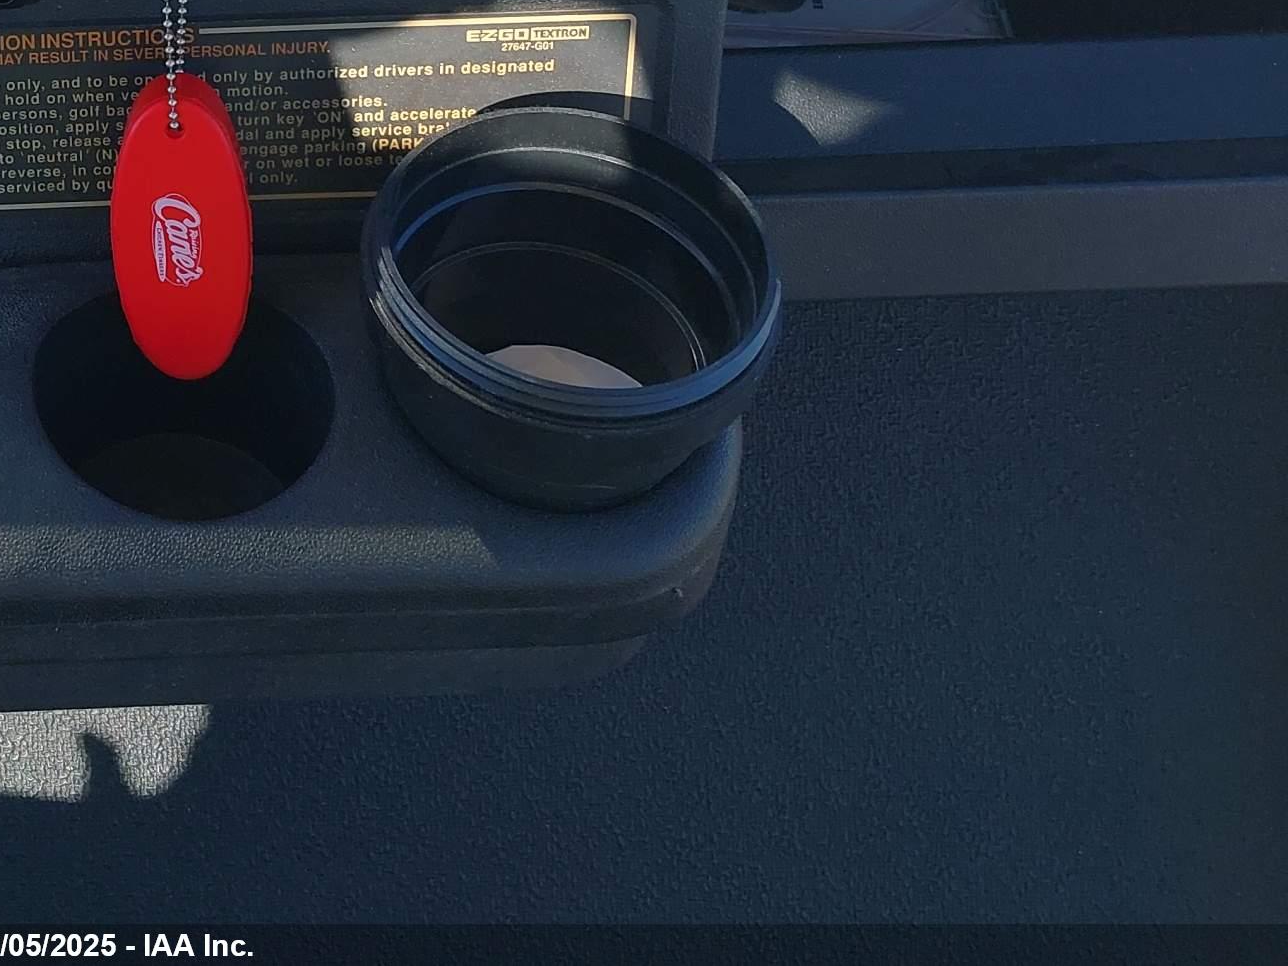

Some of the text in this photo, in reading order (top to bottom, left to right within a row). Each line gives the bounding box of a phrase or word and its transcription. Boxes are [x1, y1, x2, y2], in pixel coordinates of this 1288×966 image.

[533, 27, 588, 39] TEXTRON
[29, 50, 89, 64] RESULT
[271, 41, 331, 55] INJURY.
[501, 42, 554, 52] 27647-G01
[6, 78, 45, 92] only,
[51, 76, 81, 89] and
[213, 70, 249, 84] only
[279, 65, 368, 81] authorized
[374, 64, 434, 78] drivers
[461, 58, 555, 75] designated
[5, 93, 40, 106] hold
[72, 92, 115, 103] when
[227, 85, 289, 96] motion.
[69, 105, 99, 121] golf
[283, 95, 387, 110] accessories.
[65, 120, 109, 135] apply
[276, 113, 305, 127] key
[354, 109, 384, 123] and
[6, 138, 46, 150] stop,
[52, 136, 111, 147] release
[265, 127, 295, 139] and
[352, 123, 412, 137] service
[304, 140, 367, 155] parking
[1, 167, 66, 179] reverse,
[154, 198, 203, 285] Cane's
